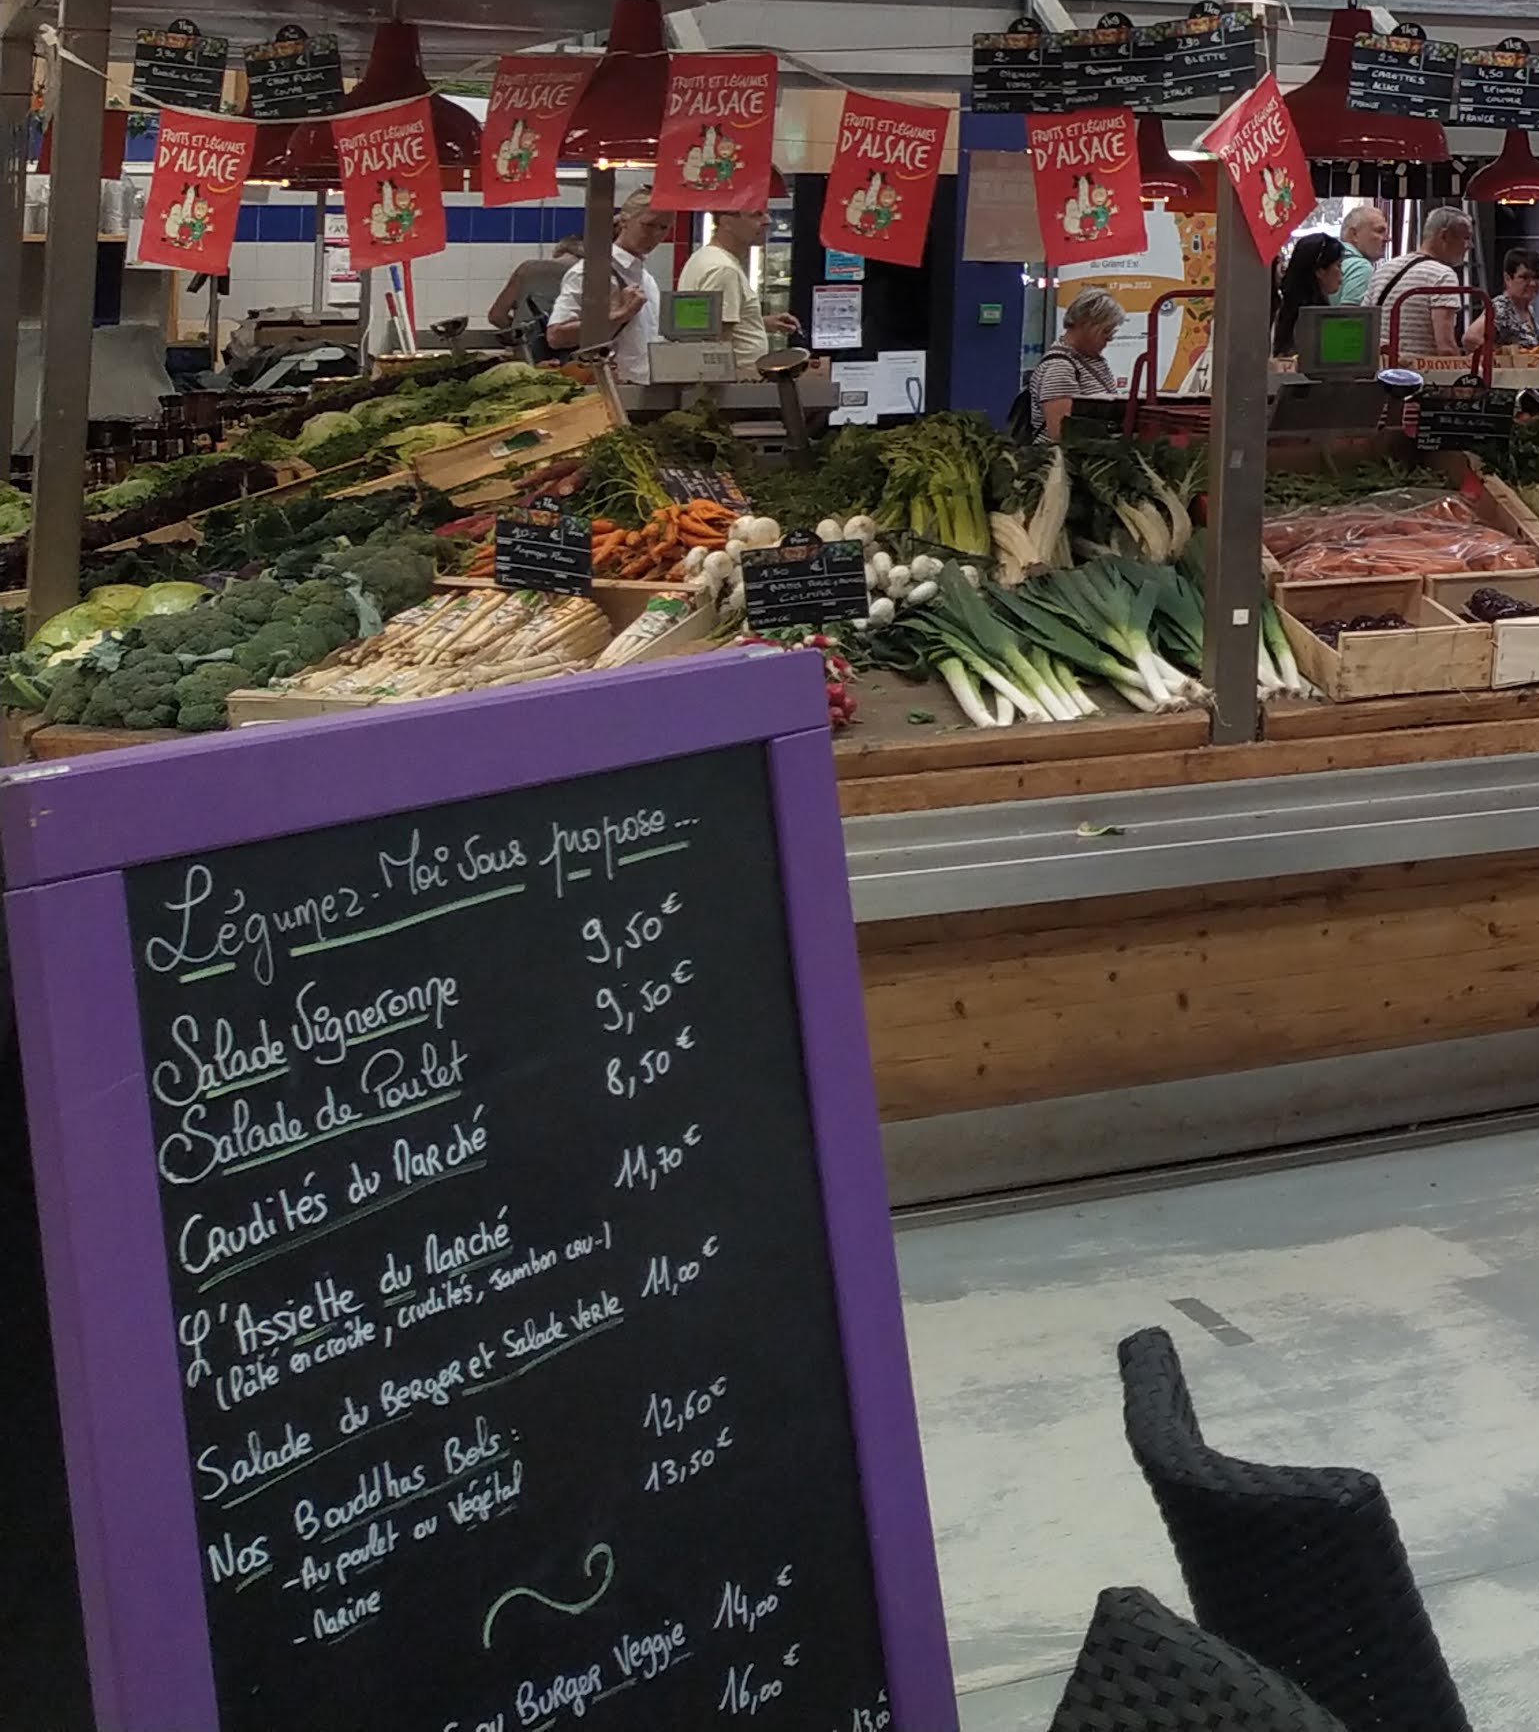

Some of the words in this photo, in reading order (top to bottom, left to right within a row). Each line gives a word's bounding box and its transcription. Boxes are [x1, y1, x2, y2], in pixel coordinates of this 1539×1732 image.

[491, 84, 570, 112] D'ALSACE
[669, 91, 765, 116] D'ALSACE
[159, 147, 240, 182] D'ALSACE
[343, 136, 426, 177] D'ALSACE
[840, 128, 929, 168] D'ALSACE
[1034, 132, 1126, 171] D'ALSACE
[1227, 112, 1287, 183] D'ALSACE
[1416, 358, 1472, 370] PROVEN
[153, 1014, 288, 1107] Salade
[158, 1099, 308, 1184] Salade
[316, 1087, 363, 1132] de
[361, 1039, 469, 1113] Poulet
[348, 1162, 381, 1204] du
[380, 1254, 412, 1295] du
[197, 1422, 313, 1502] Salade
[340, 1397, 370, 1434] du
[469, 1341, 497, 1379] et
[502, 1311, 569, 1359] Salade
[413, 1516, 439, 1541] ou
[207, 1532, 271, 1583] Nos
[613, 1620, 688, 1680] Veggie
